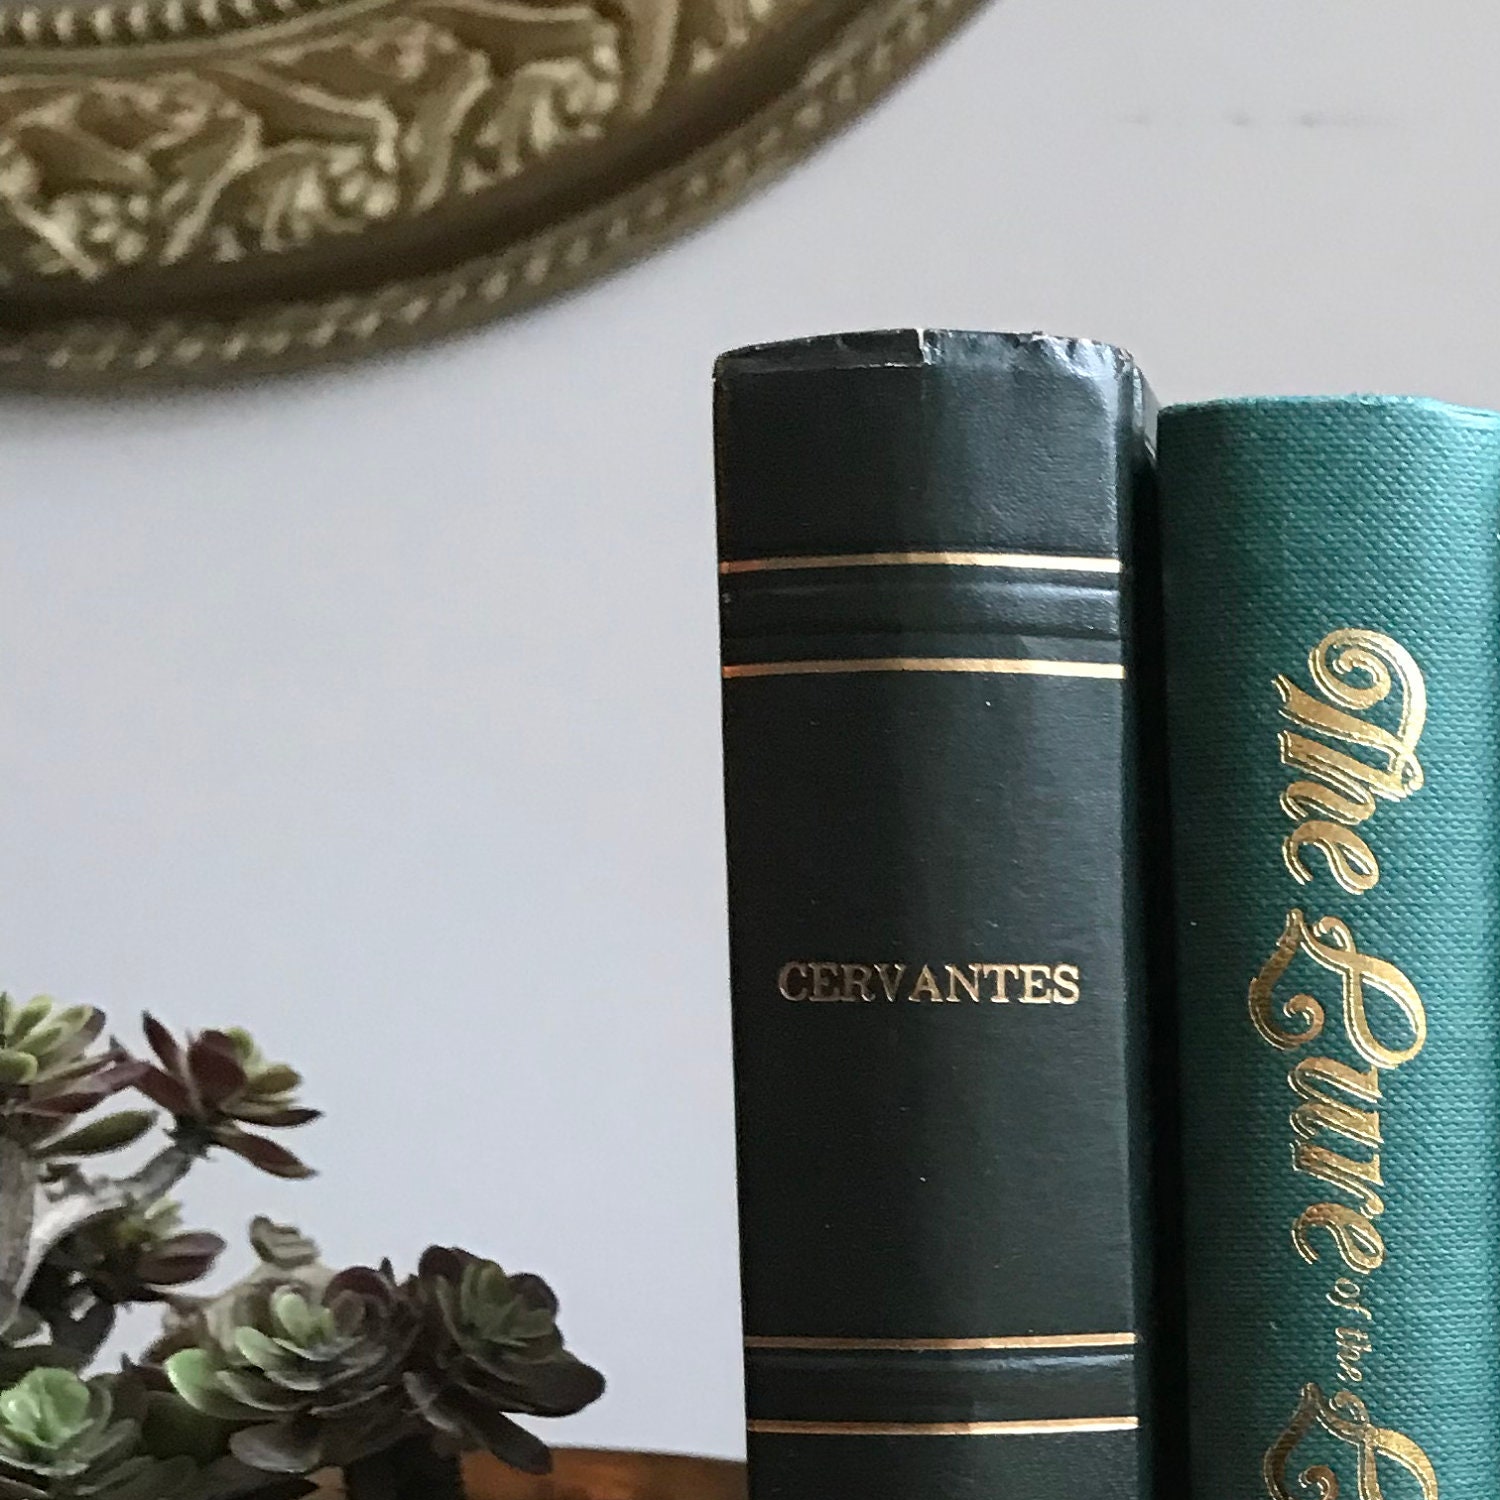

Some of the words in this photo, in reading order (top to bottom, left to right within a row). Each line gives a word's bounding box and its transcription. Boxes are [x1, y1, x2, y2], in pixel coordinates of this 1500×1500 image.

[1271, 626, 1428, 895] The
[777, 961, 1081, 1005] CERVANTES
[1248, 907, 1428, 1274] Lure
[1325, 1277, 1373, 1321] of
[1334, 1326, 1373, 1383] the
